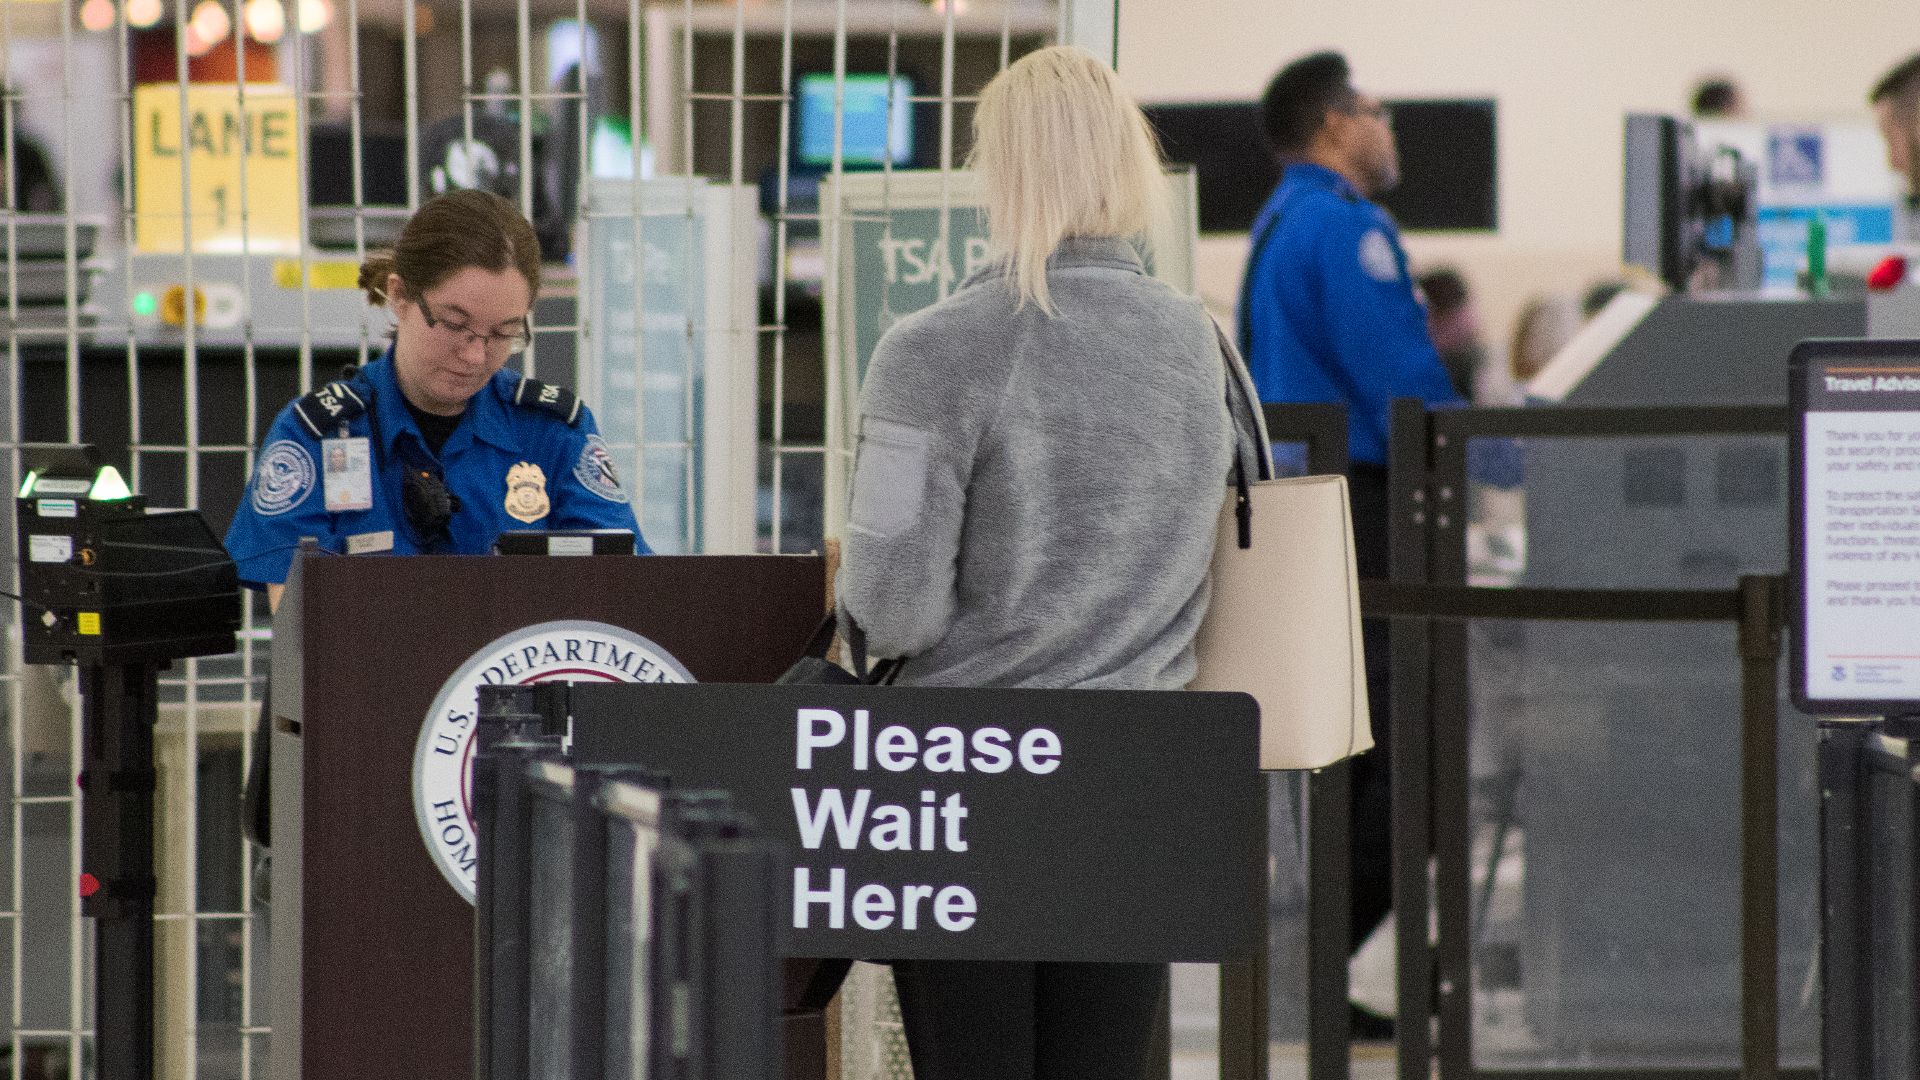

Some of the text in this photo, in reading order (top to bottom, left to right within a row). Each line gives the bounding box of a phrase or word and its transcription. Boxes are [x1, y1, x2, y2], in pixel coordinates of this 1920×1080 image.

[151, 111, 289, 158] LANE
[212, 185, 228, 229] 1
[878, 237, 991, 284] TSA P
[315, 384, 345, 418] TSA
[1824, 376, 1872, 392] Travel
[434, 637, 677, 757] U.S. DEPARTMEN
[796, 708, 1062, 775] Please
[433, 799, 477, 880] HOM
[791, 788, 968, 852] Wait
[793, 867, 978, 932] Here
